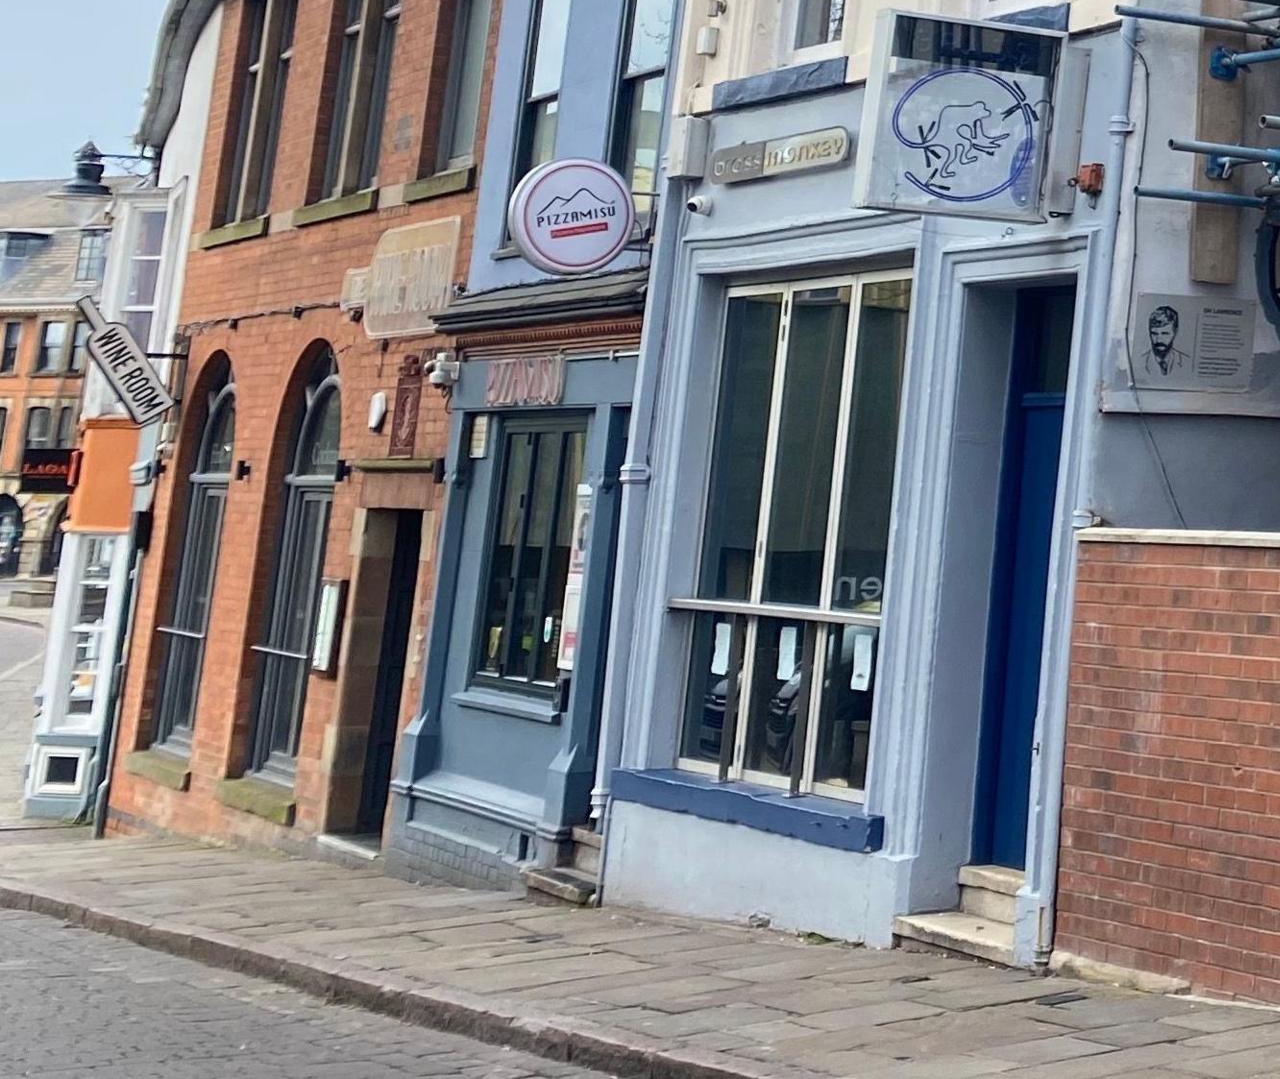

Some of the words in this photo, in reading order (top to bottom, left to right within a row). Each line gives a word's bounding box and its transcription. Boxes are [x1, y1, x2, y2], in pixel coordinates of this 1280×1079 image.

[536, 206, 616, 228] PIZZAMISU
[94, 327, 137, 373] WINE
[118, 367, 164, 415] ROOM
